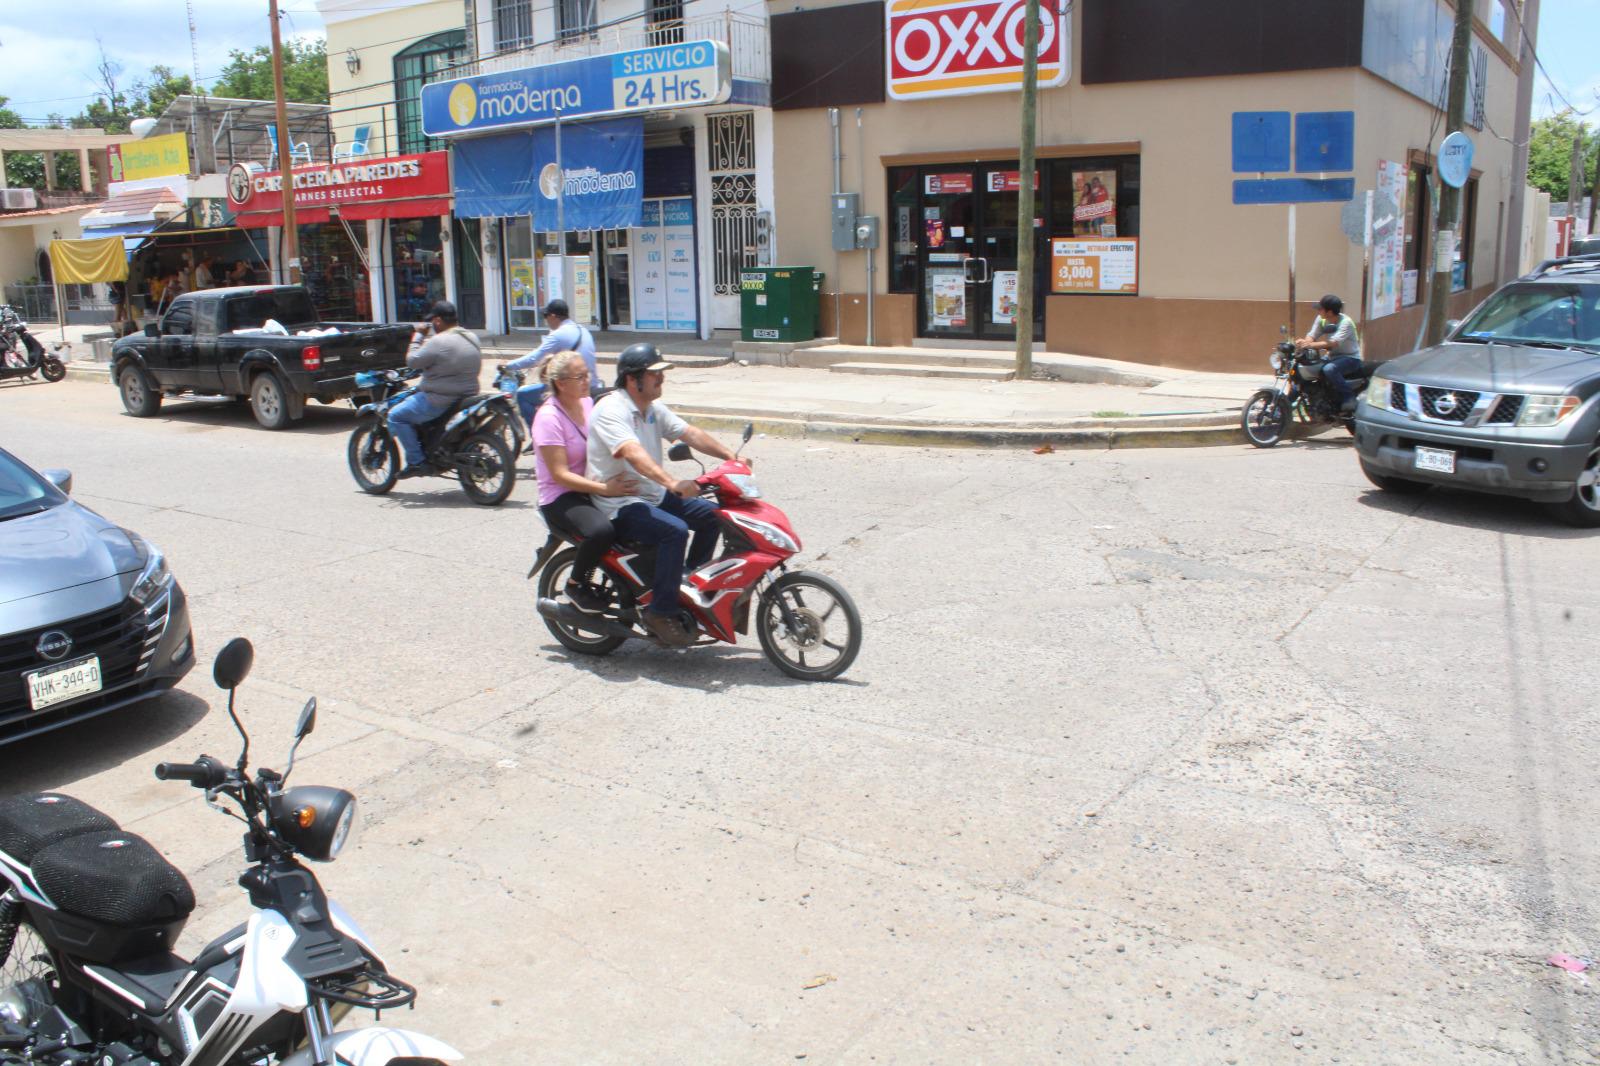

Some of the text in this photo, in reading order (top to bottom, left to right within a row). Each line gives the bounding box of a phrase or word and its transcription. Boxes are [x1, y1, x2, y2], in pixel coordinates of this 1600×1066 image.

[894, 2, 1056, 77] OXXO
[623, 46, 706, 74] SERVICIO
[478, 80, 523, 95] farmacias
[480, 85, 581, 119] moderna
[625, 75, 707, 107] 24 Hrs.
[254, 160, 420, 193] CARICERÍA PAREDES
[566, 171, 636, 195] moderna
[295, 186, 384, 202] ARNES SELECTAS
[33, 666, 99, 699] VHK-344-D
